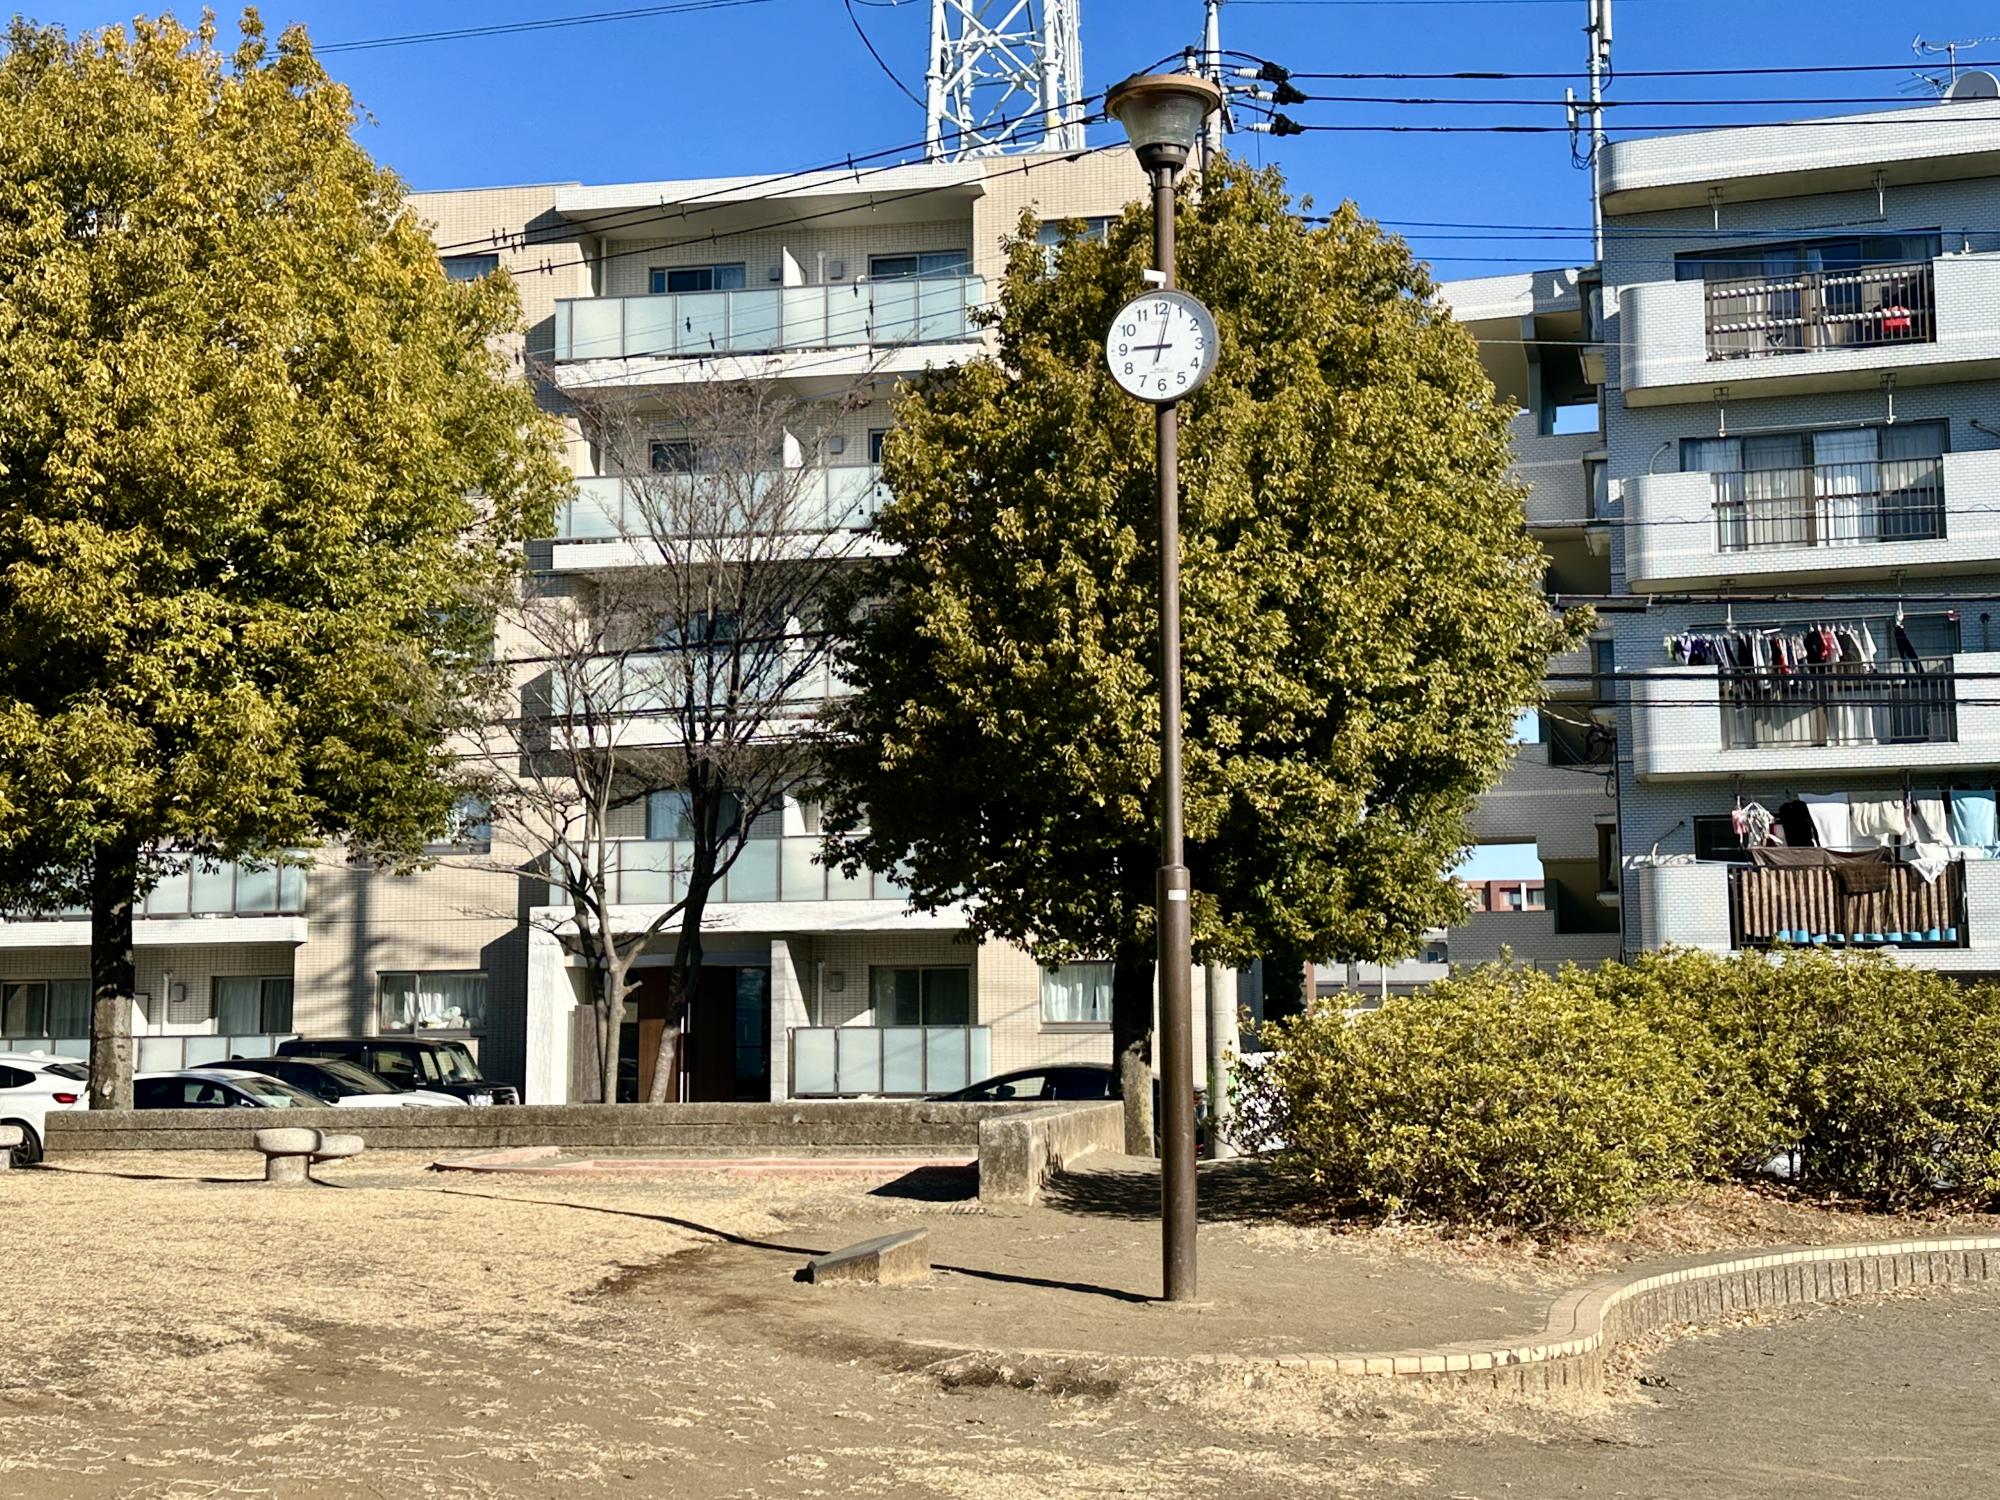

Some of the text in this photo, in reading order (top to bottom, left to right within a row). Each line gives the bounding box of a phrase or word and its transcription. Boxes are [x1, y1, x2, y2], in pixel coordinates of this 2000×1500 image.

[1154, 302, 1168, 315] 12
[1137, 309, 1148, 322] 11
[1122, 324, 1136, 337] 10
[1190, 318, 1199, 331] 2
[1119, 344, 1128, 356] 9
[1195, 337, 1204, 350] 3
[1124, 362, 1133, 375] 8
[1190, 357, 1199, 369] 4
[1139, 375, 1147, 388] 7
[1176, 372, 1186, 384] 5
[1157, 379, 1167, 391] 6
